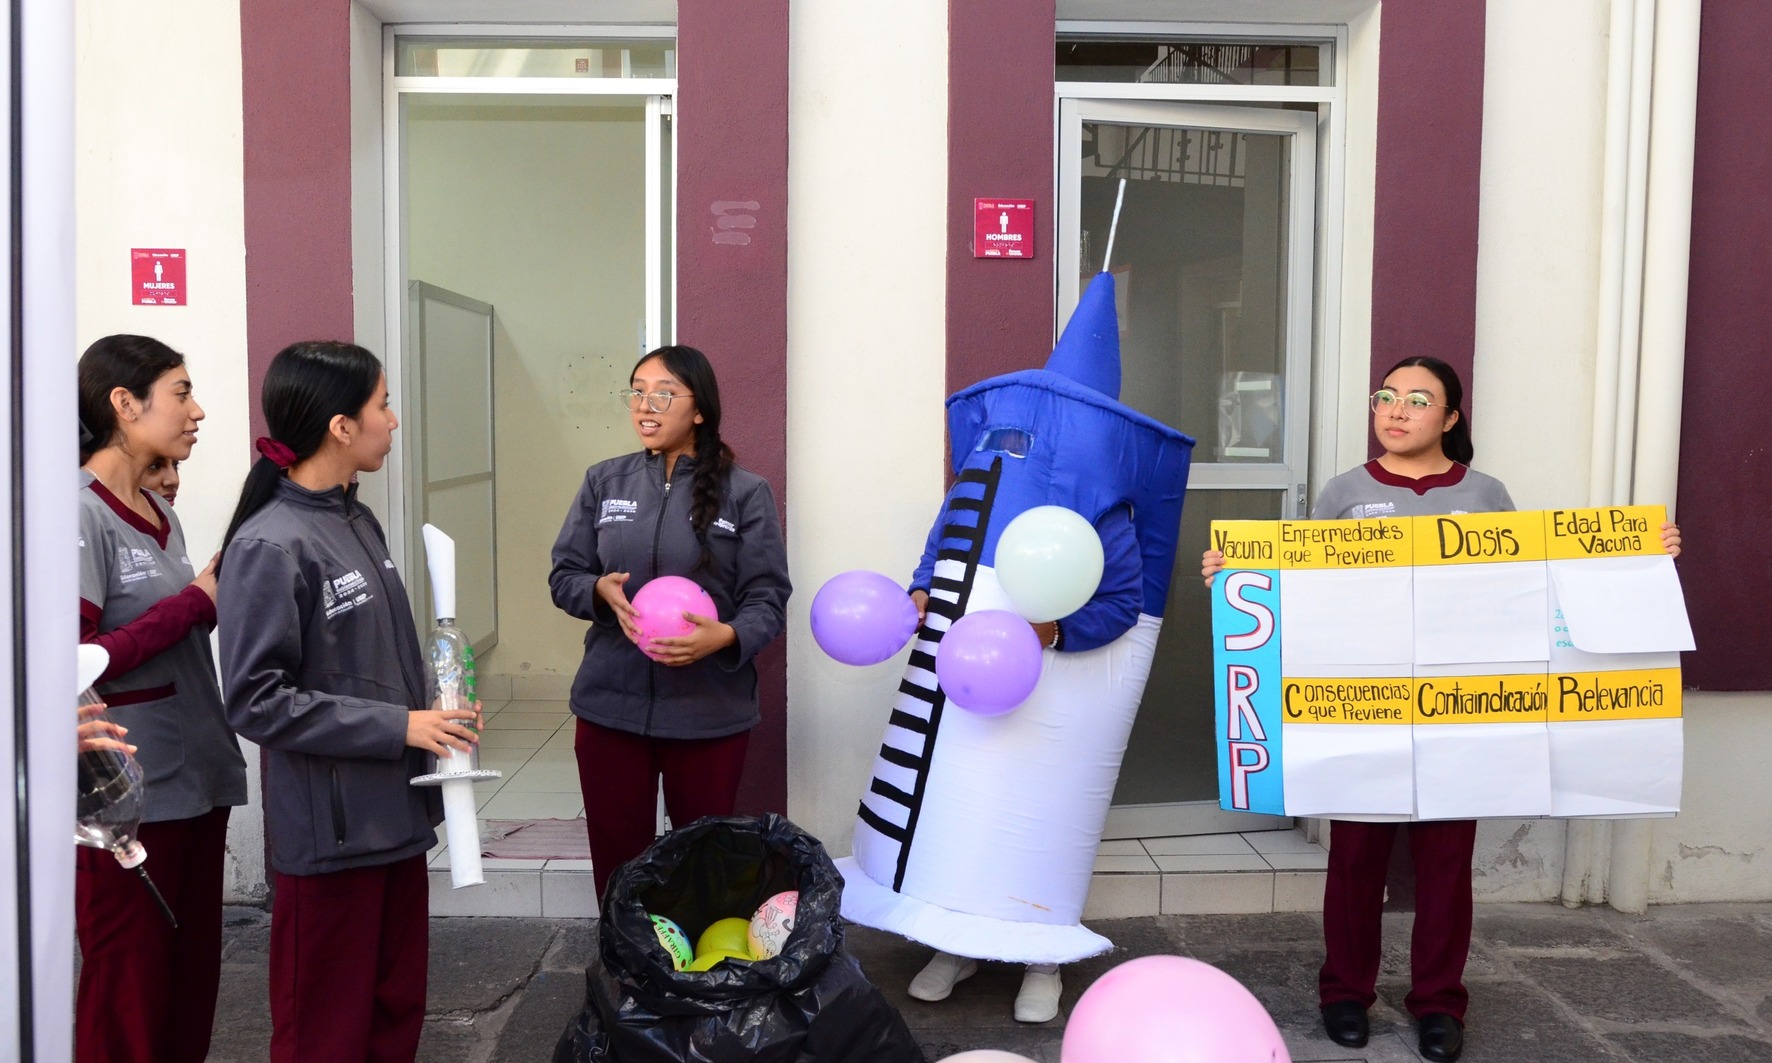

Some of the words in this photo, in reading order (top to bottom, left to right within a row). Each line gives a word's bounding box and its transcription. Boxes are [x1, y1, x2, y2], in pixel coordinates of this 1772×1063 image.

[986, 233, 1022, 241] HOMBRES
[1282, 520, 1404, 547] Enfermedades
[1554, 511, 1601, 537] Edad
[1610, 509, 1648, 533] Para
[1214, 530, 1273, 560] Vacuna
[1437, 517, 1520, 559] Dosis
[1578, 535, 1642, 554] Vacuna
[1283, 548, 1312, 566] que
[1325, 544, 1396, 566] Previene
[1285, 683, 1411, 718] Consecuencias
[1417, 681, 1548, 717] Contraindicación
[1558, 676, 1664, 713] Relevancia
[1308, 704, 1337, 721] que
[1342, 702, 1403, 720] Previene
